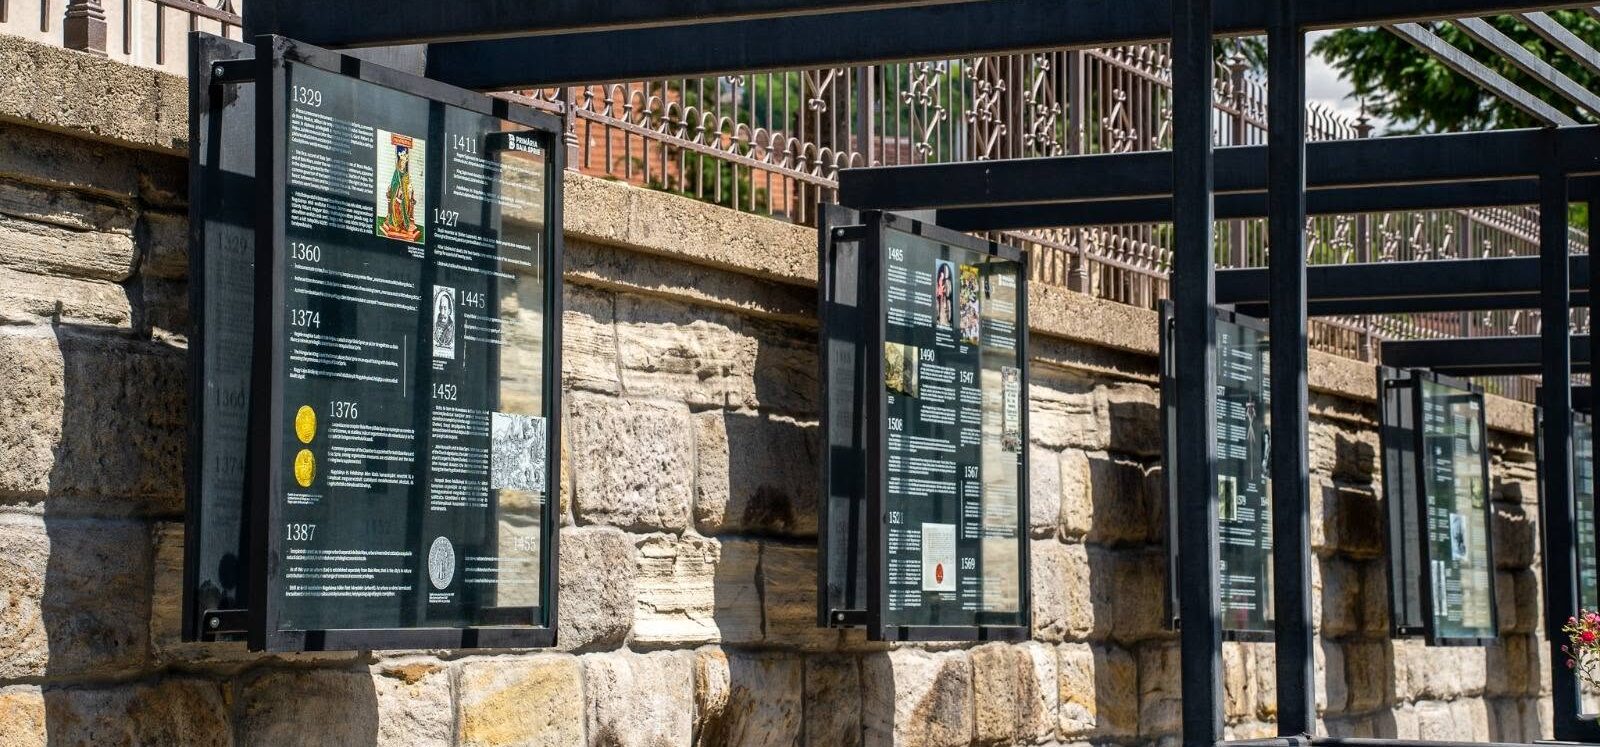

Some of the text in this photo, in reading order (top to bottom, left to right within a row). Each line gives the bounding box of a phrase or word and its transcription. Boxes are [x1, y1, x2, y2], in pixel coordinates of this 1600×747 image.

[292, 85, 322, 107] 1329
[453, 134, 477, 154] 1411
[433, 208, 459, 228] 1427
[291, 242, 321, 262] 1360
[460, 290, 485, 309] 1445
[291, 308, 321, 329] 1374
[919, 348, 935, 362] 1490
[432, 383, 457, 401] 1452
[329, 401, 358, 419] 1376
[286, 523, 317, 541] 1387
